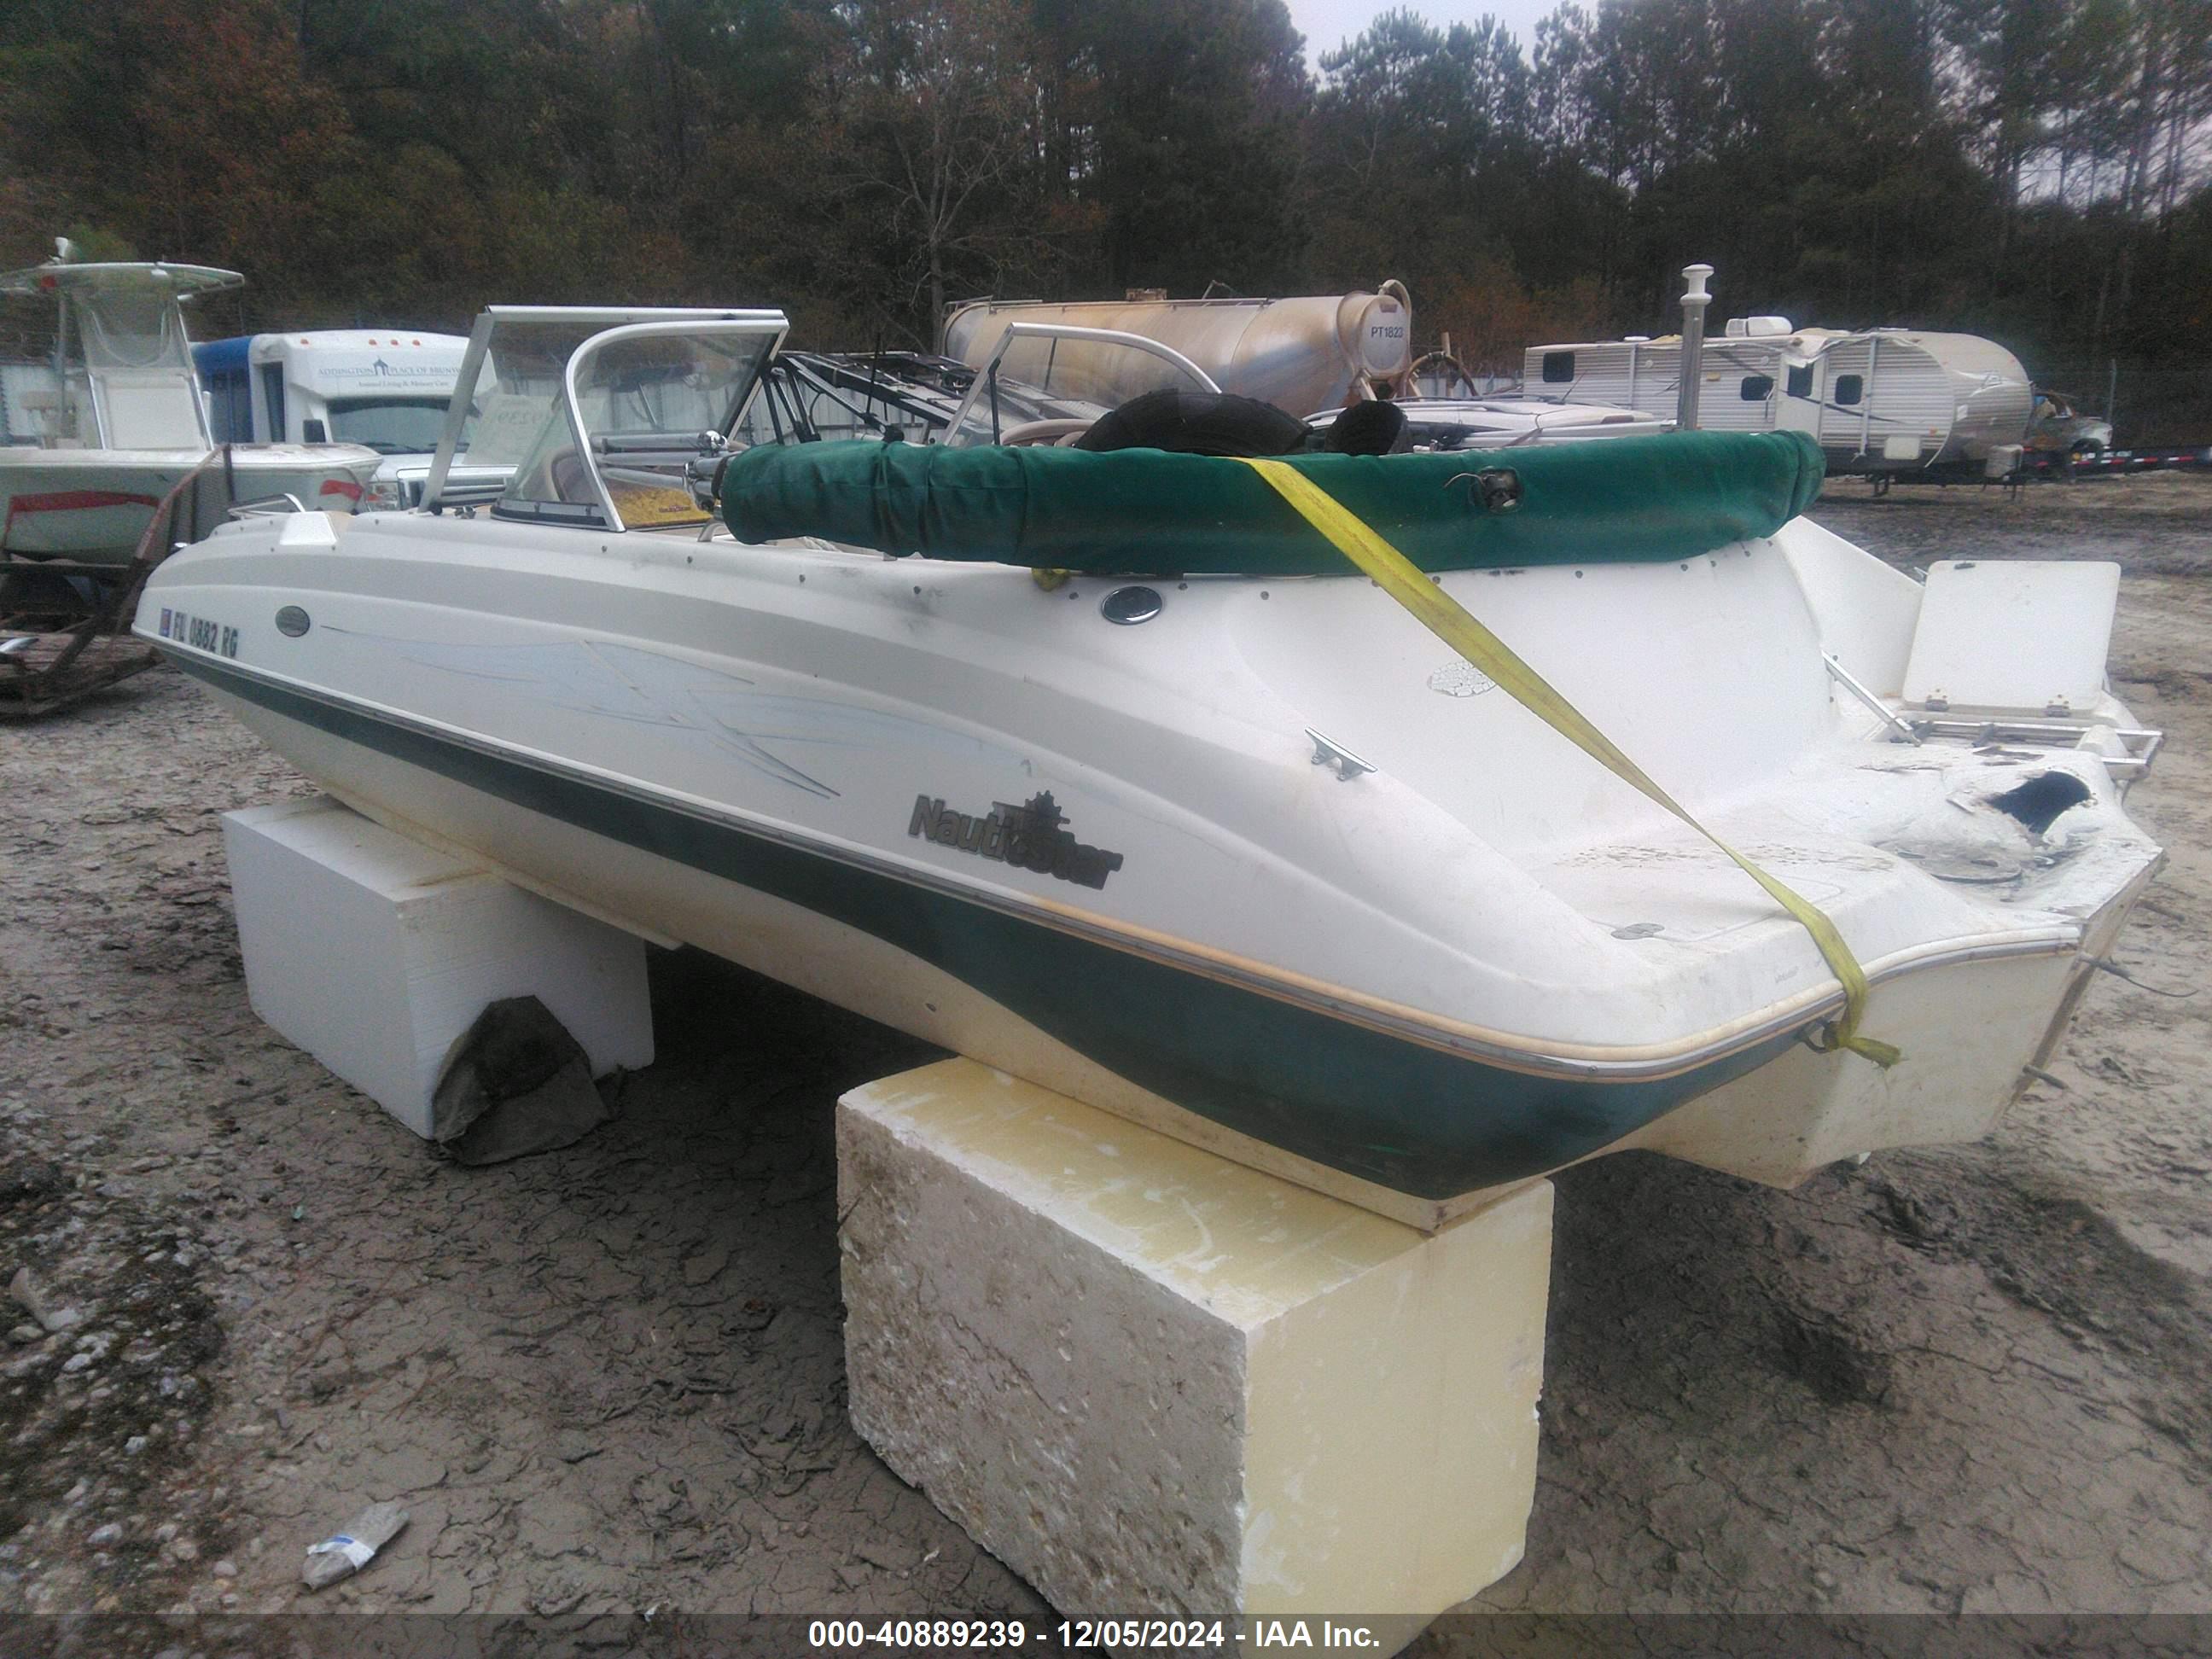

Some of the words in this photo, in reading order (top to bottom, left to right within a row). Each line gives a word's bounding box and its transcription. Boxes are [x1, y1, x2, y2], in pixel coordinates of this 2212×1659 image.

[317, 367, 374, 376] ADDINGTON
[390, 367, 415, 375] PLACE
[416, 367, 427, 375] OF
[173, 612, 186, 642] FL
[189, 616, 218, 652] 0882
[221, 626, 238, 658] RG
